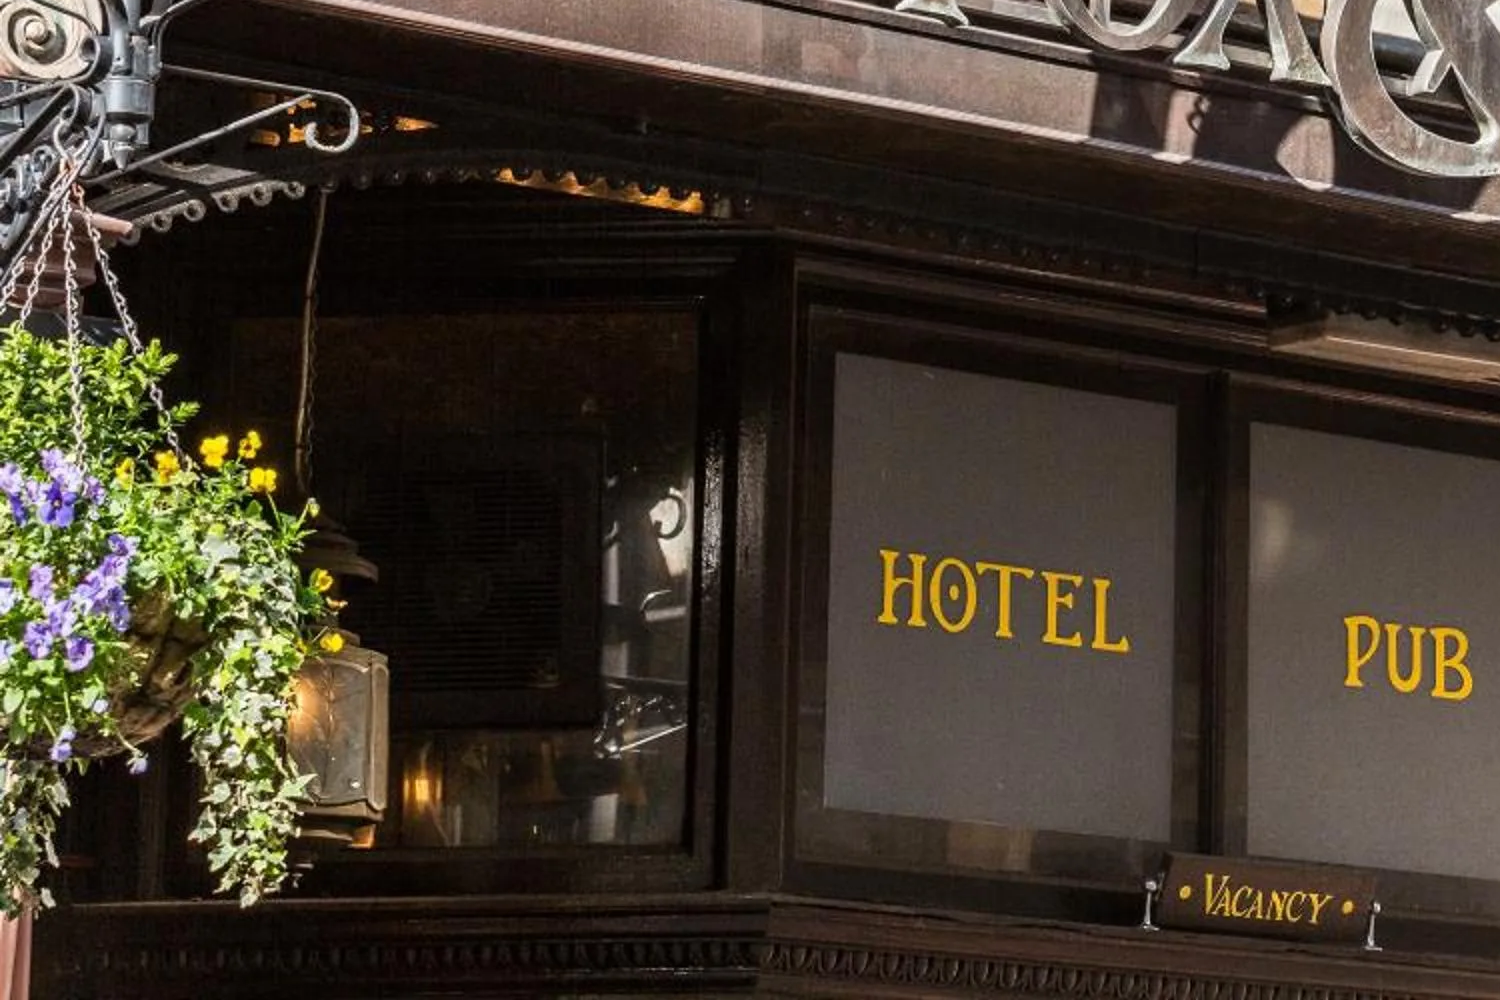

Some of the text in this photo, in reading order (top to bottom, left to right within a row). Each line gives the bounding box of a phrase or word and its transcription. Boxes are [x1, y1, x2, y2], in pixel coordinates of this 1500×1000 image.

[878, 549, 1130, 652] HOTEL
[1343, 615, 1473, 701] PUB
[1205, 873, 1332, 924] VACANCY
